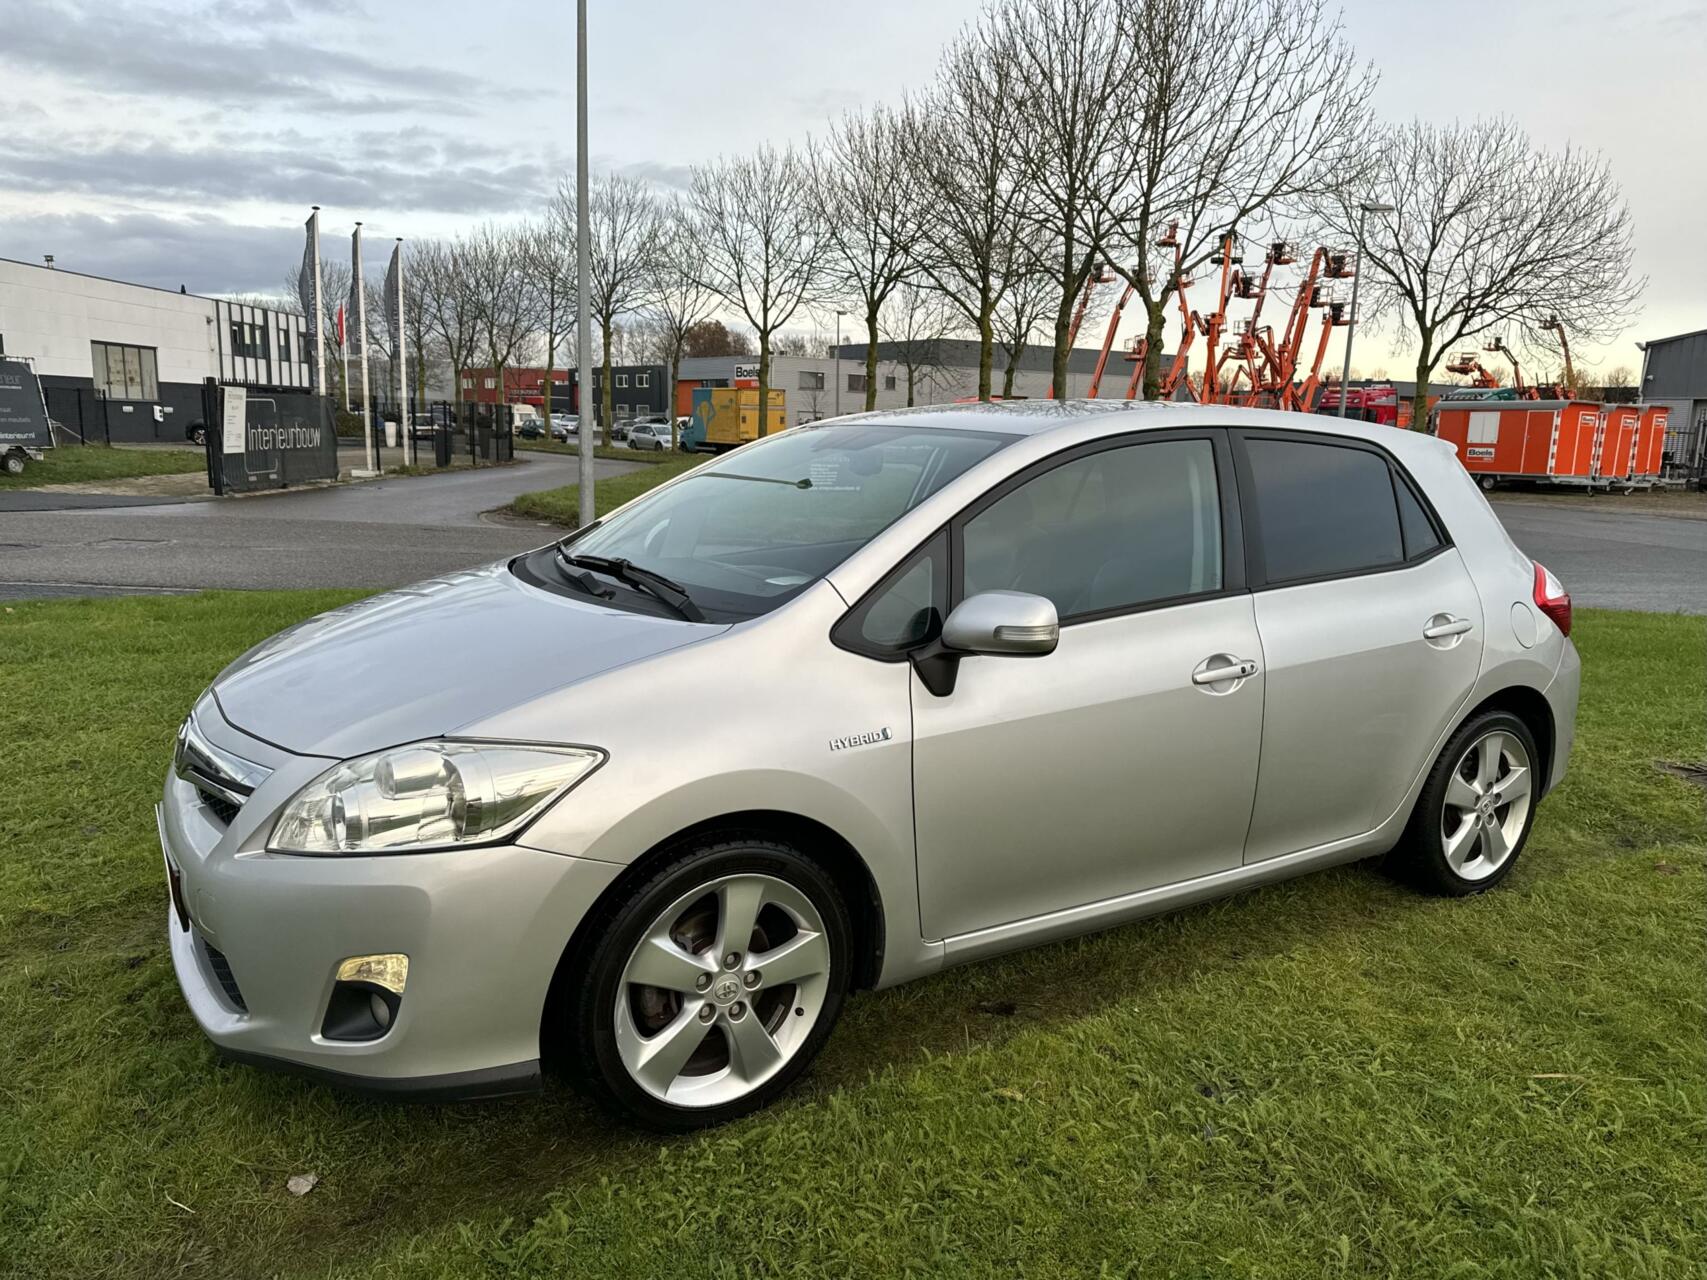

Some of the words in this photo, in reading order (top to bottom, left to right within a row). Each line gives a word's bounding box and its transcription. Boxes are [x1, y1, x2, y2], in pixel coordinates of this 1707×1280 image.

[735, 366, 760, 378] Boels
[247, 422, 321, 451] Interieurbouw
[829, 731, 881, 751] HYBRID
